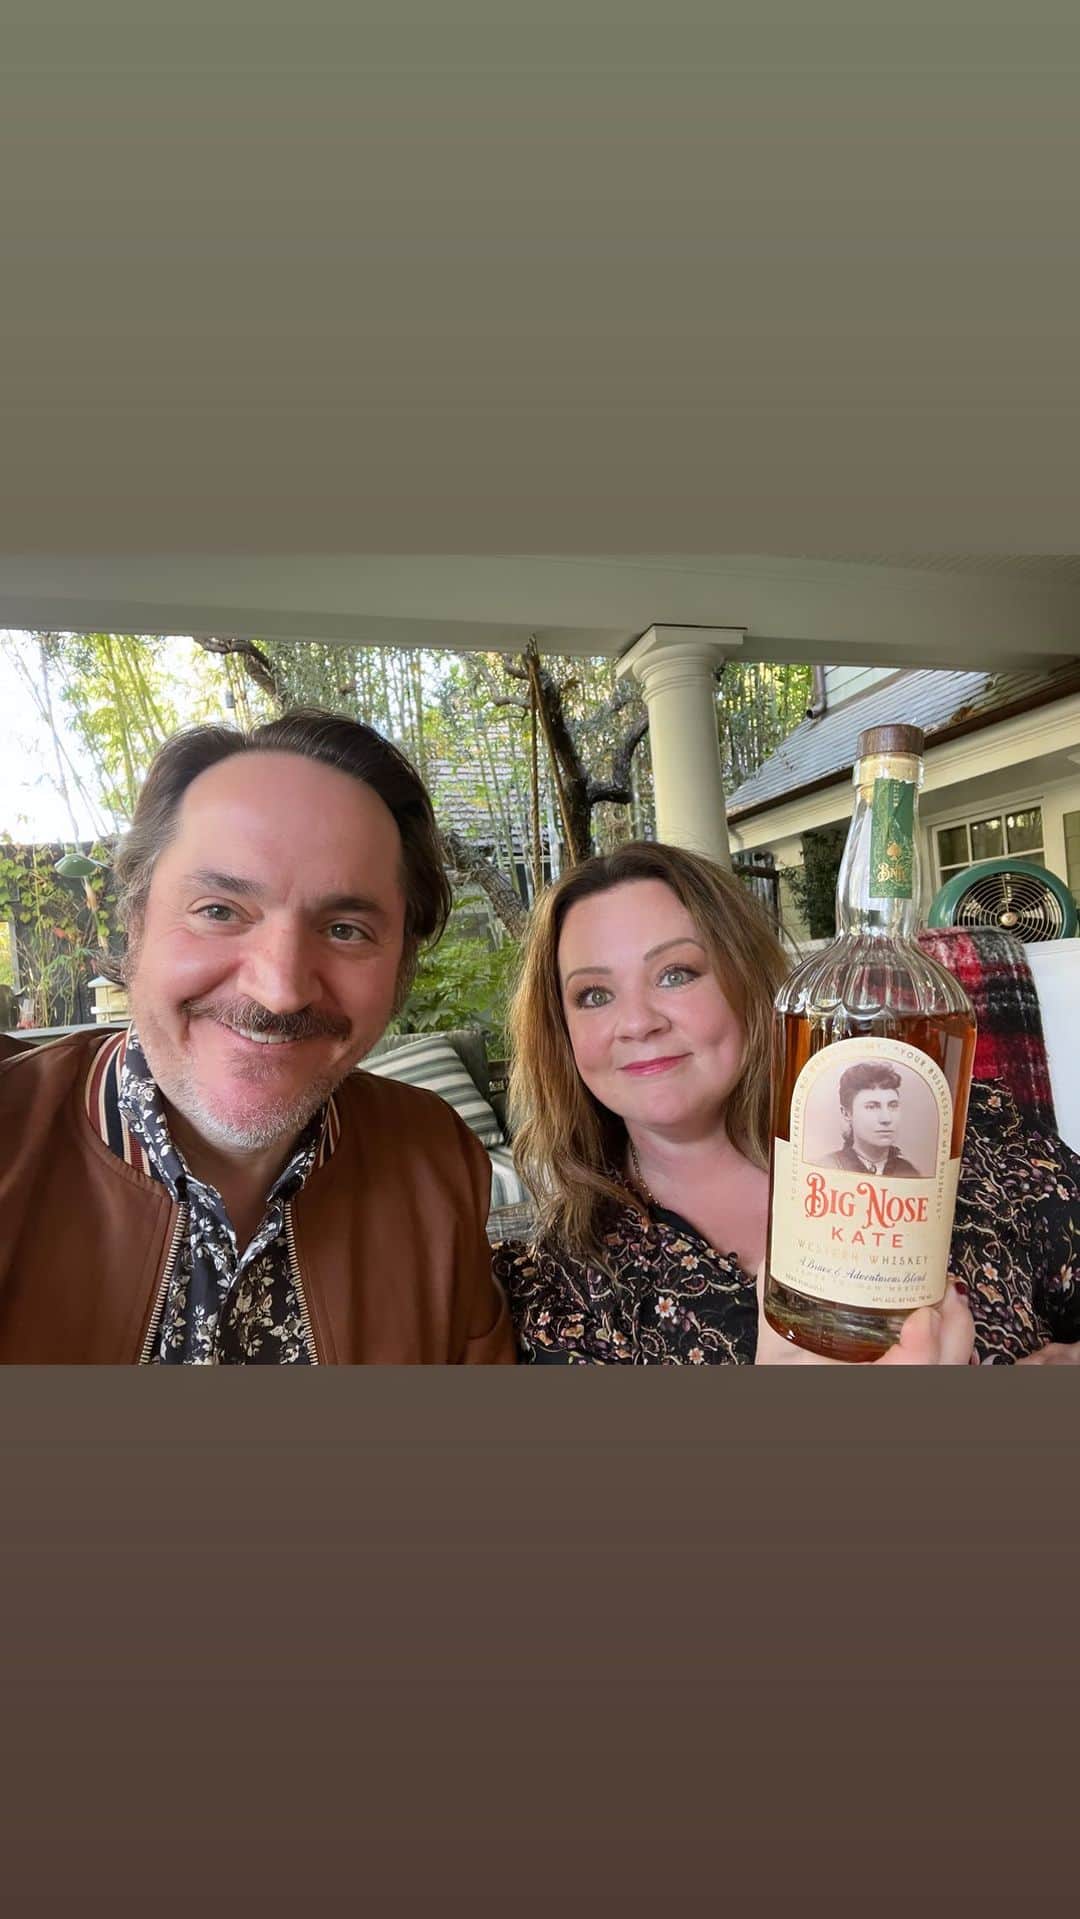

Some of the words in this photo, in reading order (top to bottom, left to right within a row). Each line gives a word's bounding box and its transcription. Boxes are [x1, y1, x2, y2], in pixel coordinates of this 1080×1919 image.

[804, 1172, 857, 1219] BIG
[856, 1182, 929, 1229] NOSE
[831, 1226, 905, 1248] KATE
[868, 1255, 929, 1265] WHISKEY
[847, 1267, 902, 1283] Adventurous
[902, 1271, 928, 1284] Blend
